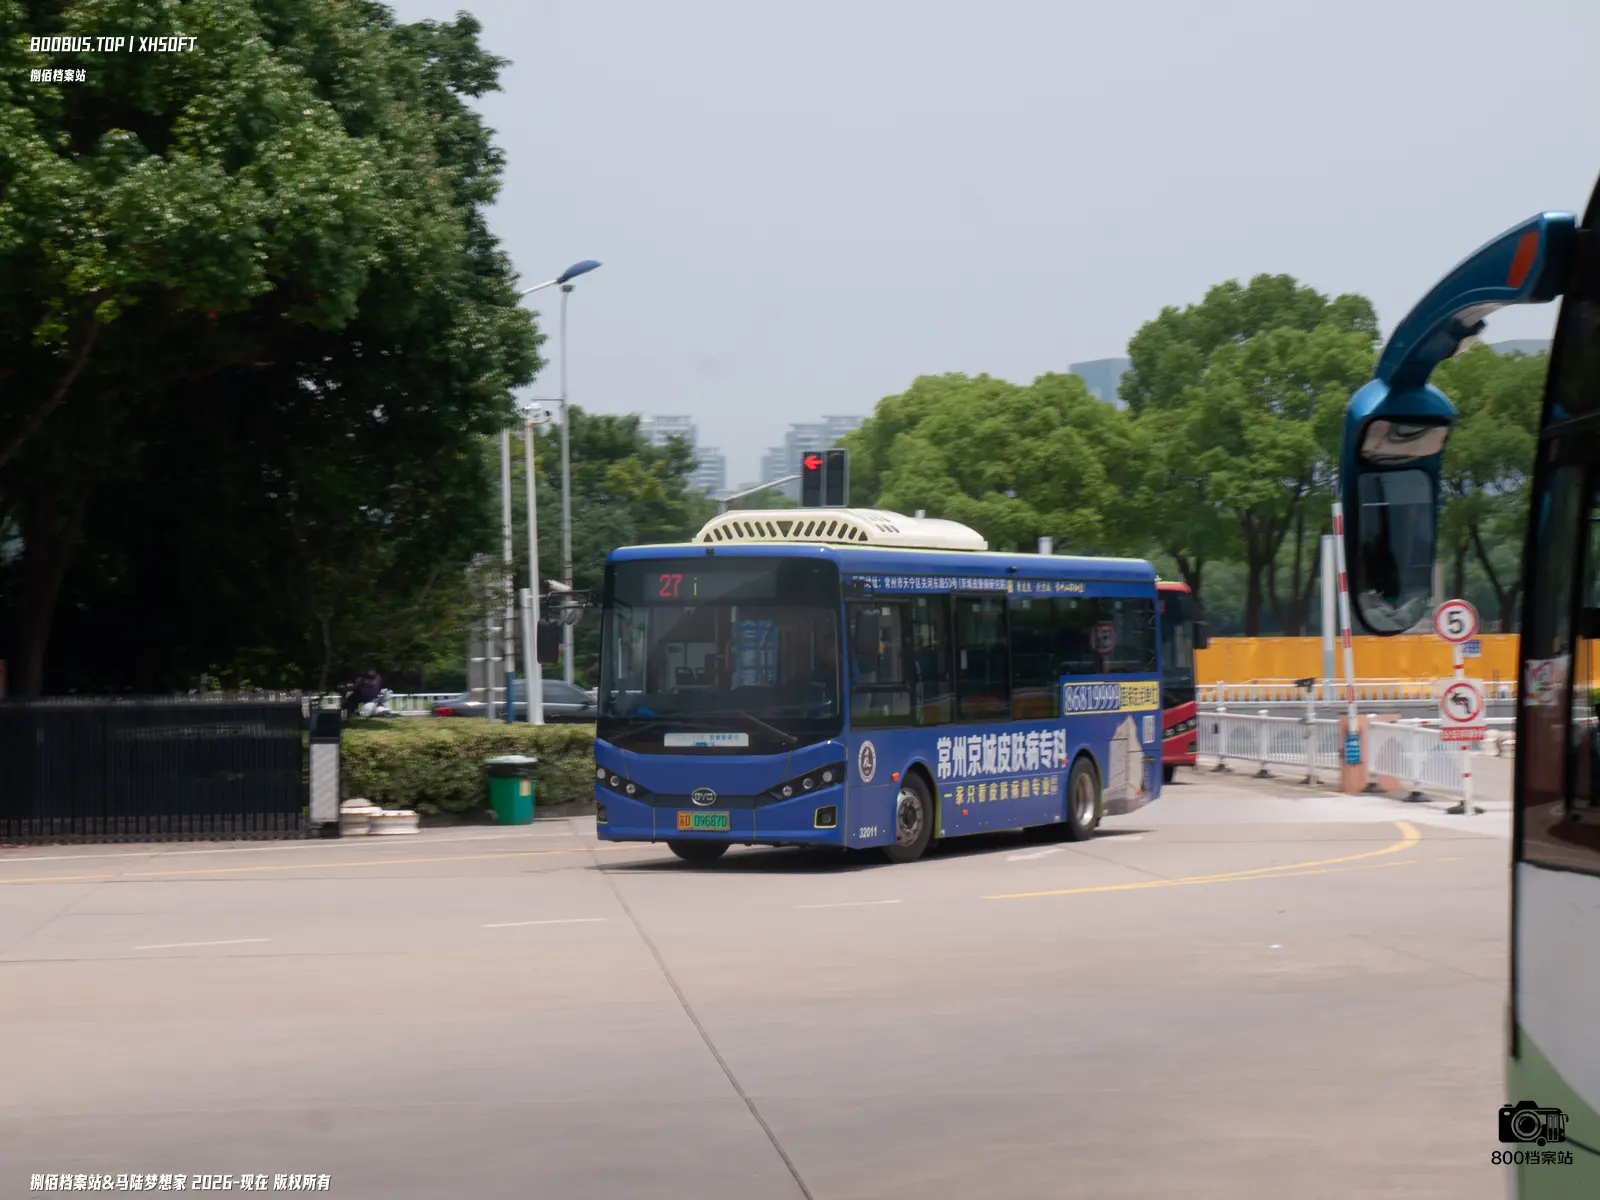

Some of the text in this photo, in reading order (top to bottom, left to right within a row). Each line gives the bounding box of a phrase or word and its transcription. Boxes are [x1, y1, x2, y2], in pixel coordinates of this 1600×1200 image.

[659, 573, 683, 597] 27
[1448, 610, 1463, 634] 5
[937, 729, 1067, 779] 常州京城皮肤病专科
[859, 826, 878, 838] 32011
